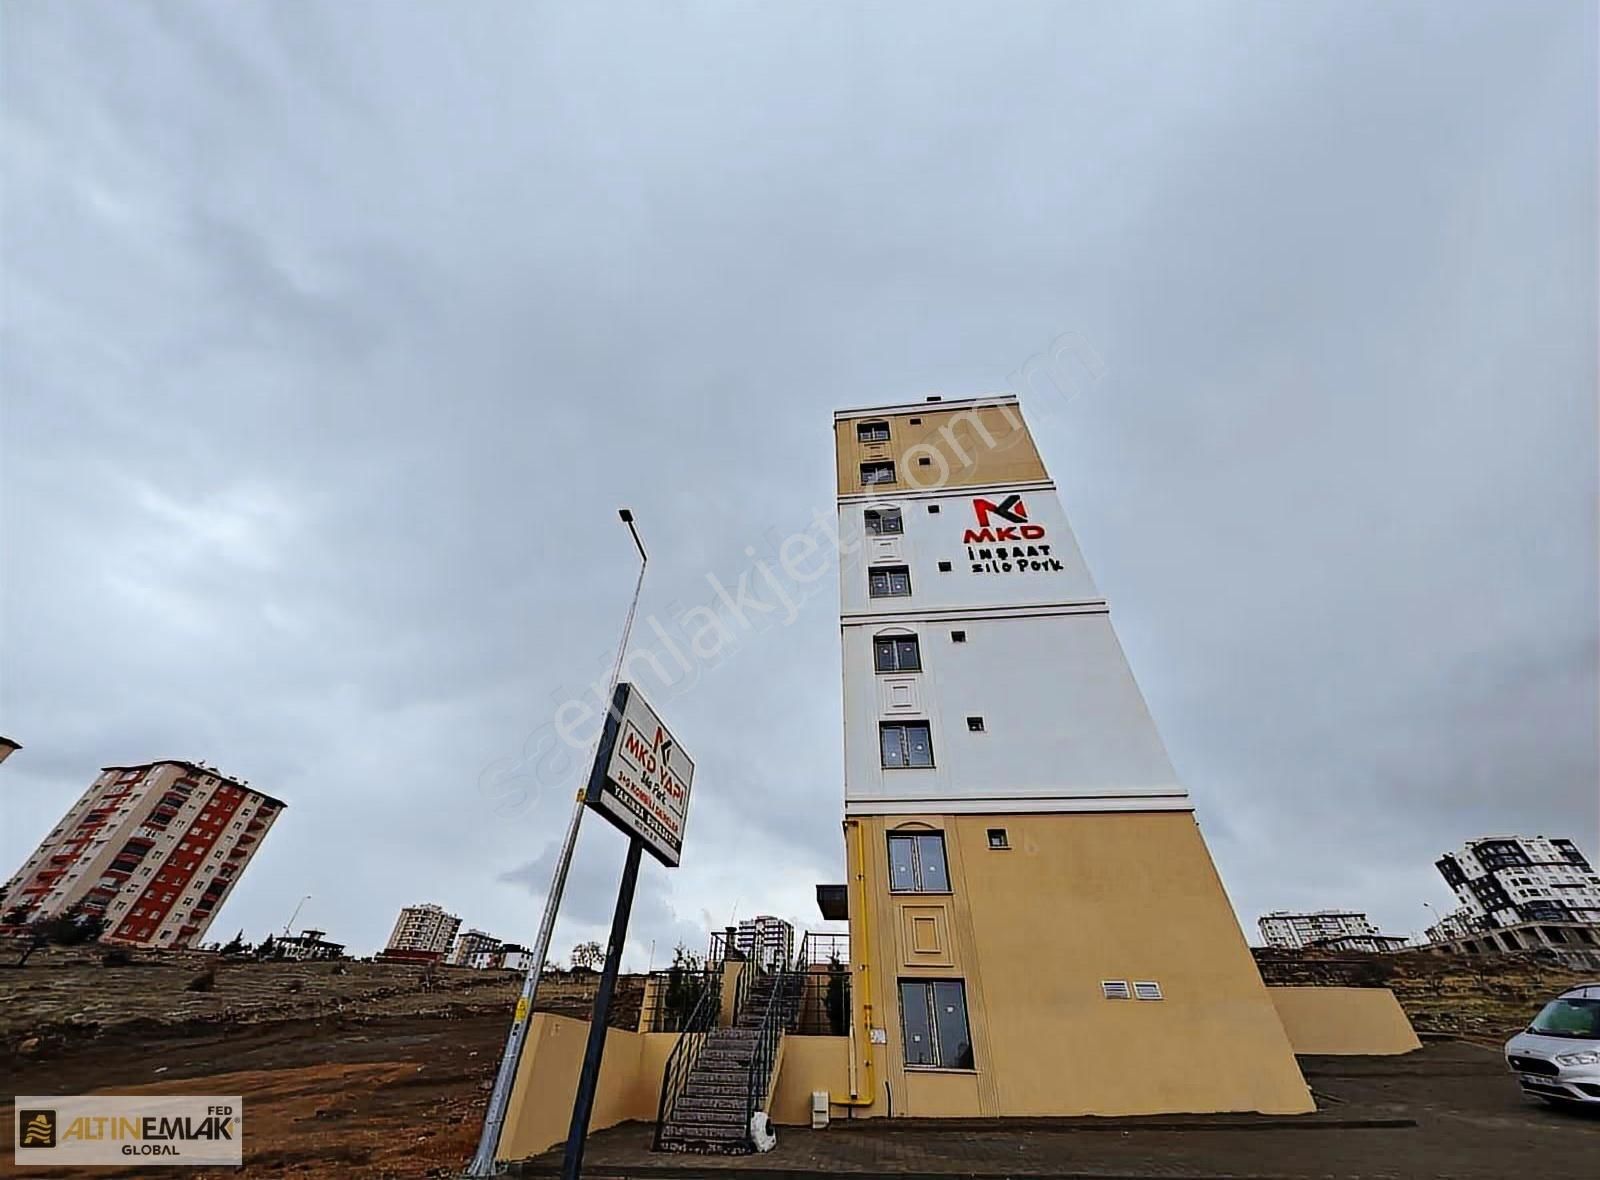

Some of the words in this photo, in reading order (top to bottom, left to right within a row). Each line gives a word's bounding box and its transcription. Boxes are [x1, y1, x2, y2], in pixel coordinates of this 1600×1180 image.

[963, 525, 1045, 544] MKD
[626, 733, 656, 773] MKD
[660, 766, 684, 805] YAPI
